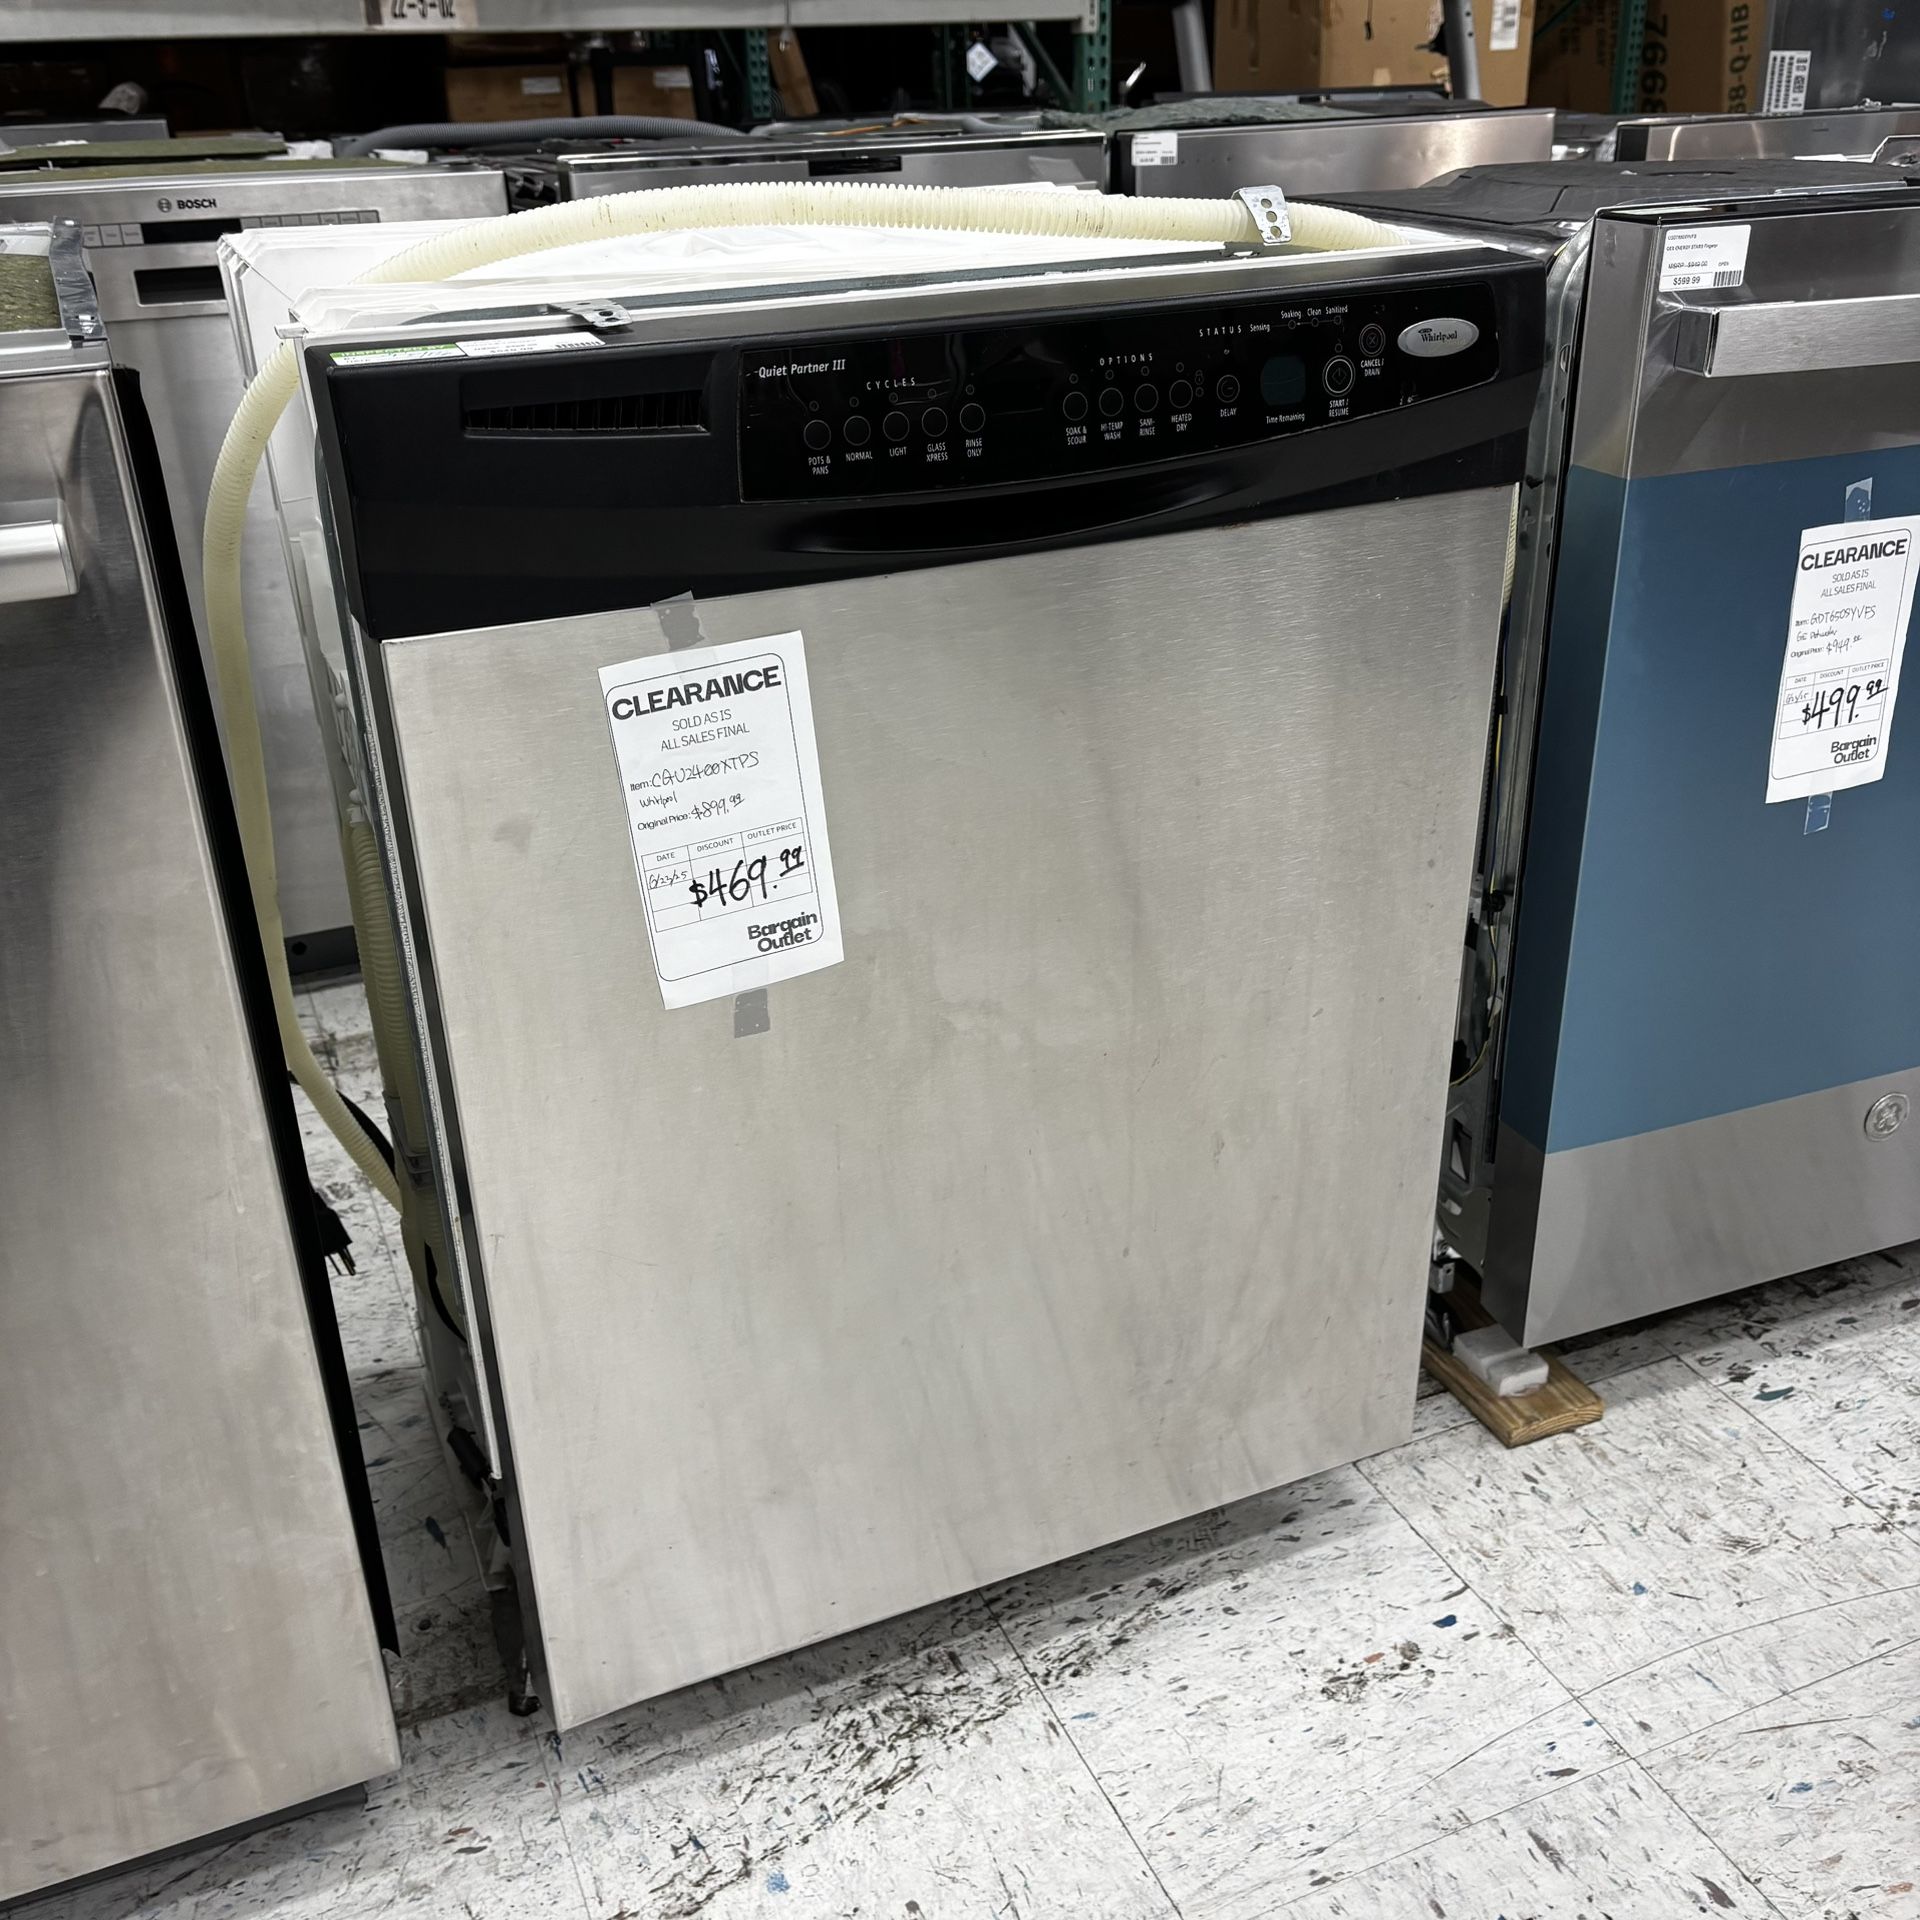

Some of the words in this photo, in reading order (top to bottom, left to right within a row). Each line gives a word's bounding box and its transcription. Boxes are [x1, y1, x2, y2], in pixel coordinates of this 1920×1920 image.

[177, 199, 217, 210] BOSCH
[1281, 309, 1301, 320] Soaking
[1307, 307, 1321, 316] Clean
[1325, 304, 1348, 314] Sanitized
[1199, 325, 1242, 337] STATUS
[1250, 322, 1270, 332] Sensing
[1421, 330, 1458, 343] Whirlpool
[1100, 353, 1153, 366] OPTIONS
[758, 366, 788, 379] Quiet
[790, 361, 829, 375] Partner
[832, 359, 846, 371] III
[1364, 368, 1381, 377] DRAIN
[866, 377, 916, 391] CYCLES
[1171, 413, 1192, 423] HEATED
[1220, 408, 1237, 417] DELAY
[1266, 415, 1278, 425] Time
[1279, 412, 1305, 423] Remaining
[1329, 407, 1349, 417] RESUME
[1065, 427, 1081, 436] SOAK
[1082, 425, 1087, 434] &
[1139, 427, 1155, 436] RINSE
[1176, 423, 1188, 432] DRY
[1067, 435, 1087, 445] SCOUR
[1104, 431, 1121, 440] WASH
[927, 442, 946, 453] GLASS
[965, 438, 982, 448] RINSE
[845, 451, 873, 462] NORMAL
[889, 446, 907, 457] LIGHT
[926, 452, 948, 463] XPRESS
[967, 448, 982, 458] ONLY
[808, 456, 824, 466] POTS
[825, 456, 831, 465] &
[812, 466, 829, 475] PANS
[1801, 538, 1908, 571] CLEARANCE
[1832, 571, 1850, 583] SOLD
[1851, 569, 1861, 579] AS
[1861, 568, 1869, 578] IS
[1820, 588, 1833, 599] ALL
[1834, 583, 1855, 596] SALES
[1856, 580, 1877, 592] FINAL
[1797, 630, 1807, 642] GE
[1794, 676, 1807, 684] DATE
[1820, 669, 1844, 679] DISCOUNT
[1852, 664, 1871, 673] OUTLET
[612, 665, 782, 720] CLEARANCE
[1802, 679, 1888, 729] $499.99
[672, 715, 702, 732] SOLD
[703, 711, 719, 725] AS
[720, 708, 732, 721] IS
[661, 738, 682, 751] ALL
[681, 730, 715, 747] SALES
[717, 722, 750, 739] FINAL
[1831, 734, 1877, 753] Bargain
[1833, 748, 1870, 764] Outlet
[630, 780, 652, 792] Item:
[637, 816, 668, 831] Original
[669, 812, 691, 824] Price:
[656, 852, 675, 862] DATE
[697, 838, 733, 852] DISCOUNT
[747, 828, 775, 840] OUTLET
[776, 822, 797, 833] PRICE
[689, 846, 805, 907] $469.99
[747, 911, 818, 940] Bargain
[757, 927, 813, 953] Outlet
